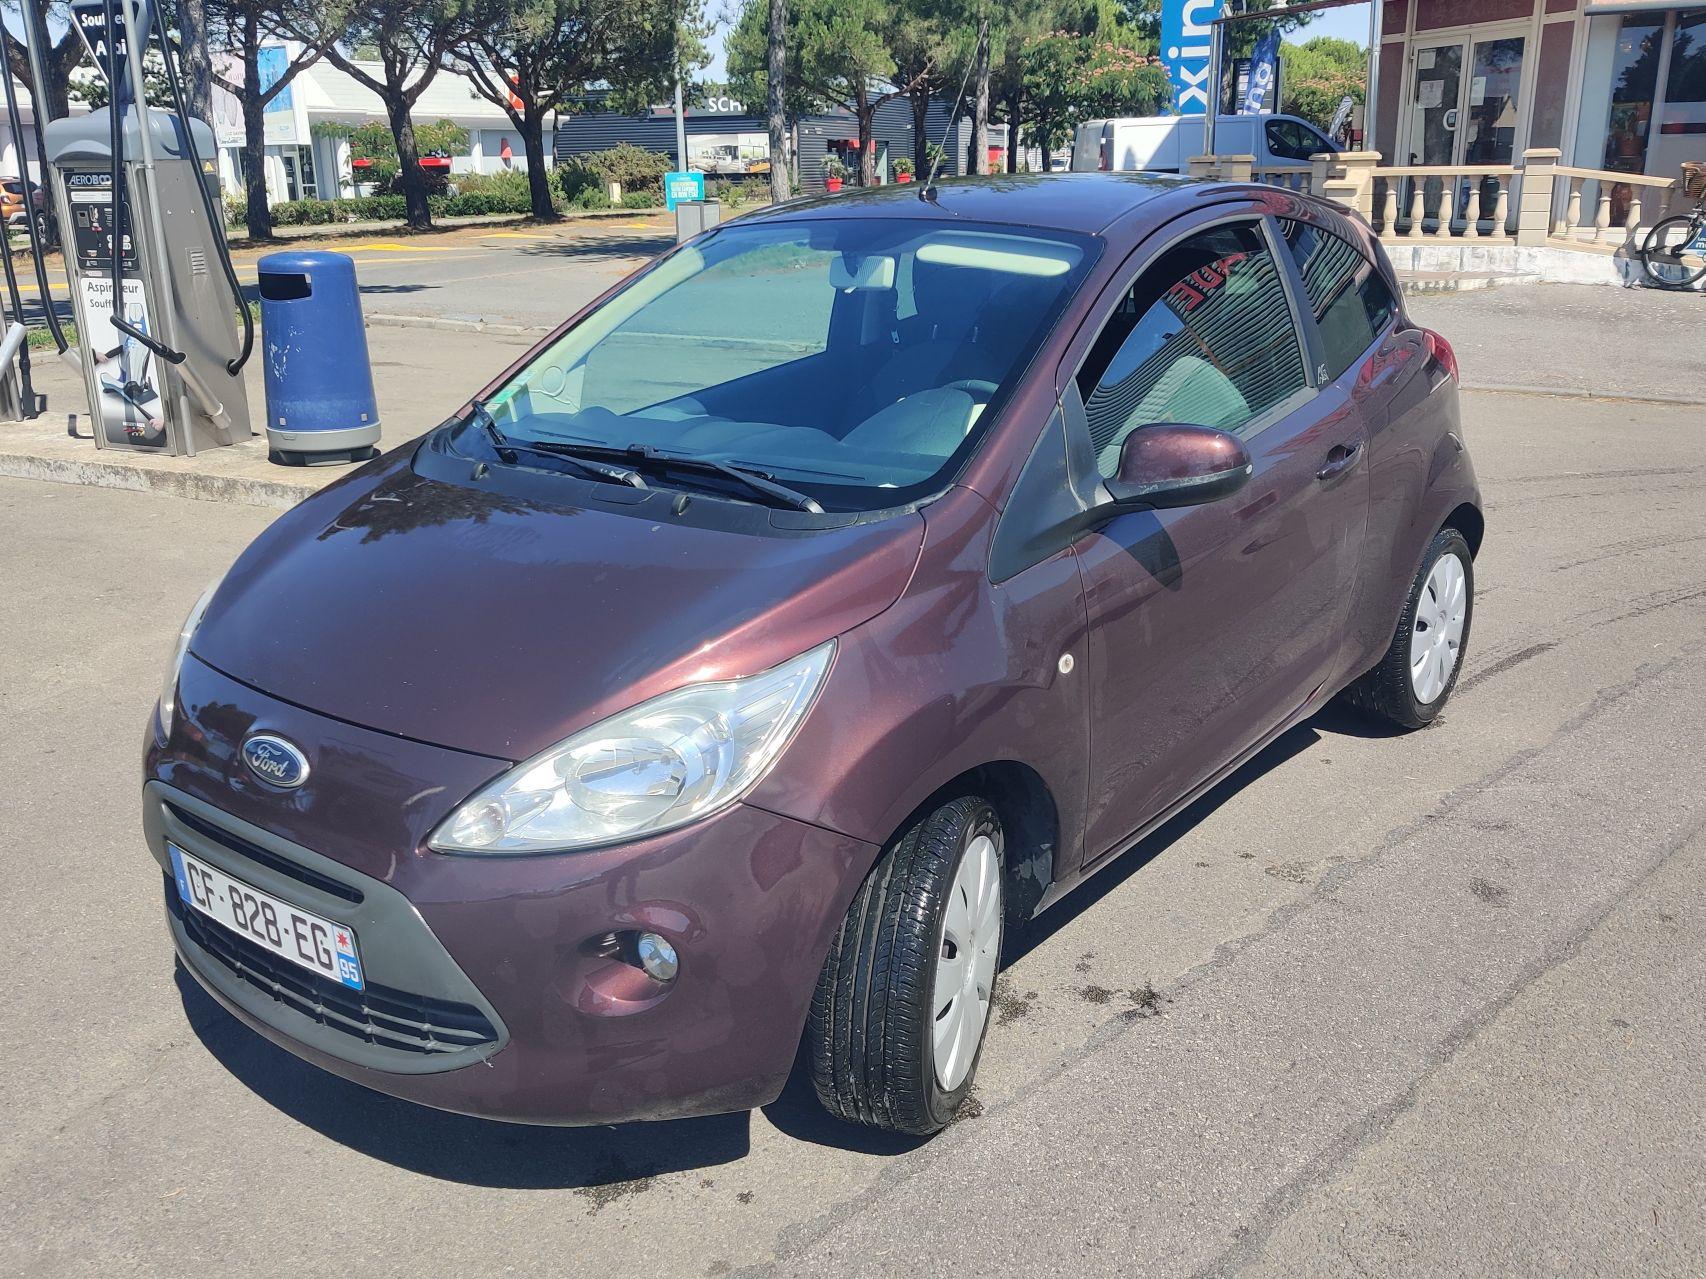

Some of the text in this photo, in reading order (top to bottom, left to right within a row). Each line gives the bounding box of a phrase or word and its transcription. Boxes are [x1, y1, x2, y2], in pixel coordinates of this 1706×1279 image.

[708, 96, 748, 112] SCH
[87, 281, 139, 296] Aspireur
[252, 743, 290, 778] Ford
[339, 957, 360, 983] 95
